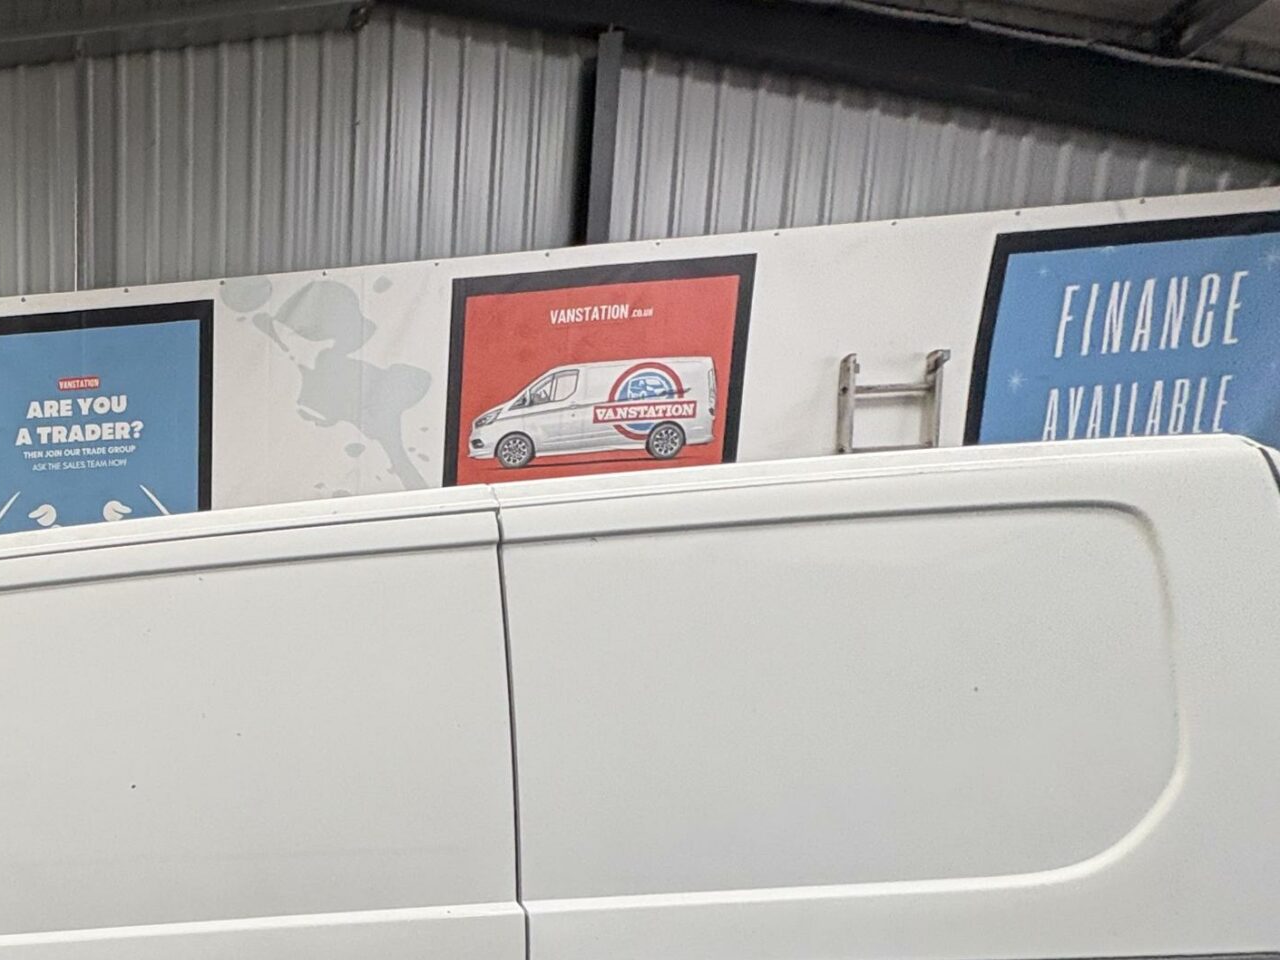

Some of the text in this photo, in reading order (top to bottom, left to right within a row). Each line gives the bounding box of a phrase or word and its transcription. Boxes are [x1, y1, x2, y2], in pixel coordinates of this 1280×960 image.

[550, 304, 629, 325] VANSTATION
[1054, 271, 1249, 358] FINANCE
[58, 378, 100, 390] VANSTATION
[26, 395, 128, 419] ARE YOU
[596, 403, 695, 420] VANSTATION
[1042, 374, 1233, 441] AVAILABLE
[15, 420, 144, 446] A TRADER?
[23, 444, 137, 460] THEN JOIN OUR TRADE GROUP
[32, 463, 48, 472] ASK
[48, 462, 62, 471] THE
[62, 460, 87, 470] SALES
[86, 459, 108, 469] TEAM
